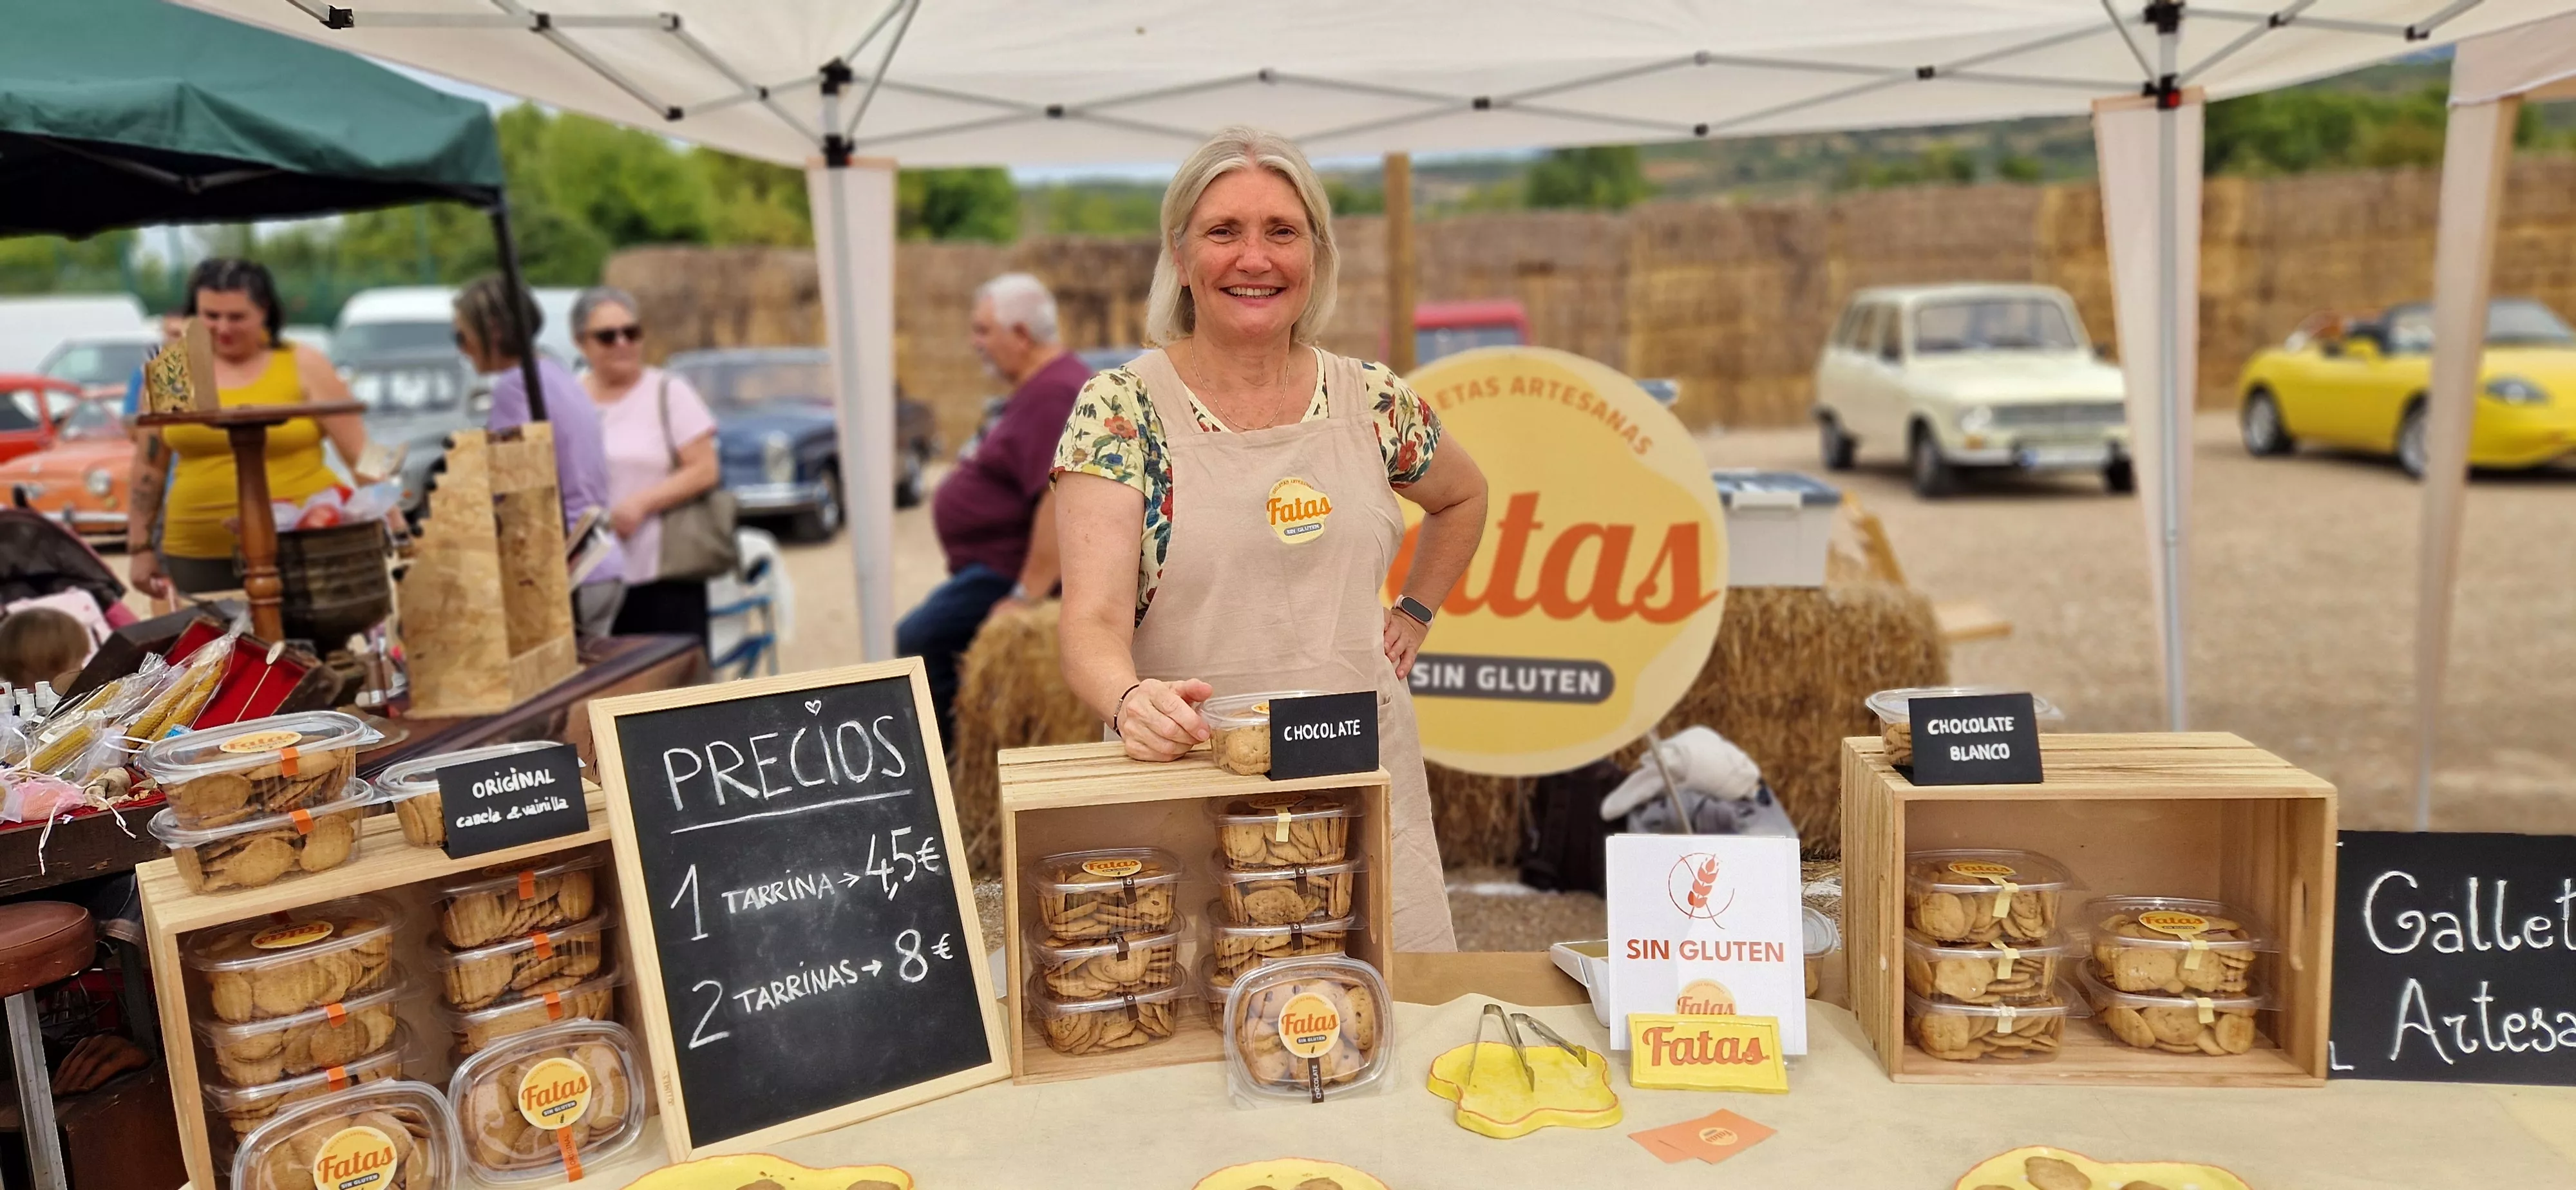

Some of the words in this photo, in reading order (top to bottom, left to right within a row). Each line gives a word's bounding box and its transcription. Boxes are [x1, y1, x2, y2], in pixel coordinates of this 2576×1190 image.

[1434, 375, 1501, 411] ETAS
[1510, 375, 1654, 456] ARTESANAS
[1265, 497, 1333, 525] Fatas
[1297, 524, 1320, 533] GLUTEN
[1411, 662, 1466, 689] SIN
[1476, 665, 1600, 695] GLUTEN
[1283, 719, 1361, 741] CHOCOLATE
[1927, 716, 2015, 735] CHOCOLATE
[663, 715, 907, 811] PRECIOS
[1949, 743, 2011, 761] BLANCO
[471, 766, 556, 798] ORIGINAL
[522, 796, 569, 815] vainilla
[1084, 860, 1140, 871] Fatas
[670, 864, 709, 941] 1
[721, 869, 835, 914] TARRINA
[2141, 916, 2205, 925] Fatas
[1626, 939, 1670, 960] SIN
[1679, 940, 1785, 962] GLUTEN
[688, 979, 730, 1050] 2
[732, 959, 859, 1014] TARRINAS
[1677, 996, 1736, 1015] Fatas
[1281, 1013, 1339, 1035] Fatas
[1642, 1026, 1770, 1066] Fatas
[521, 1076, 591, 1111] Fatas
[317, 1146, 395, 1184] Fatas
[353, 1173, 379, 1185] GLUTEN
